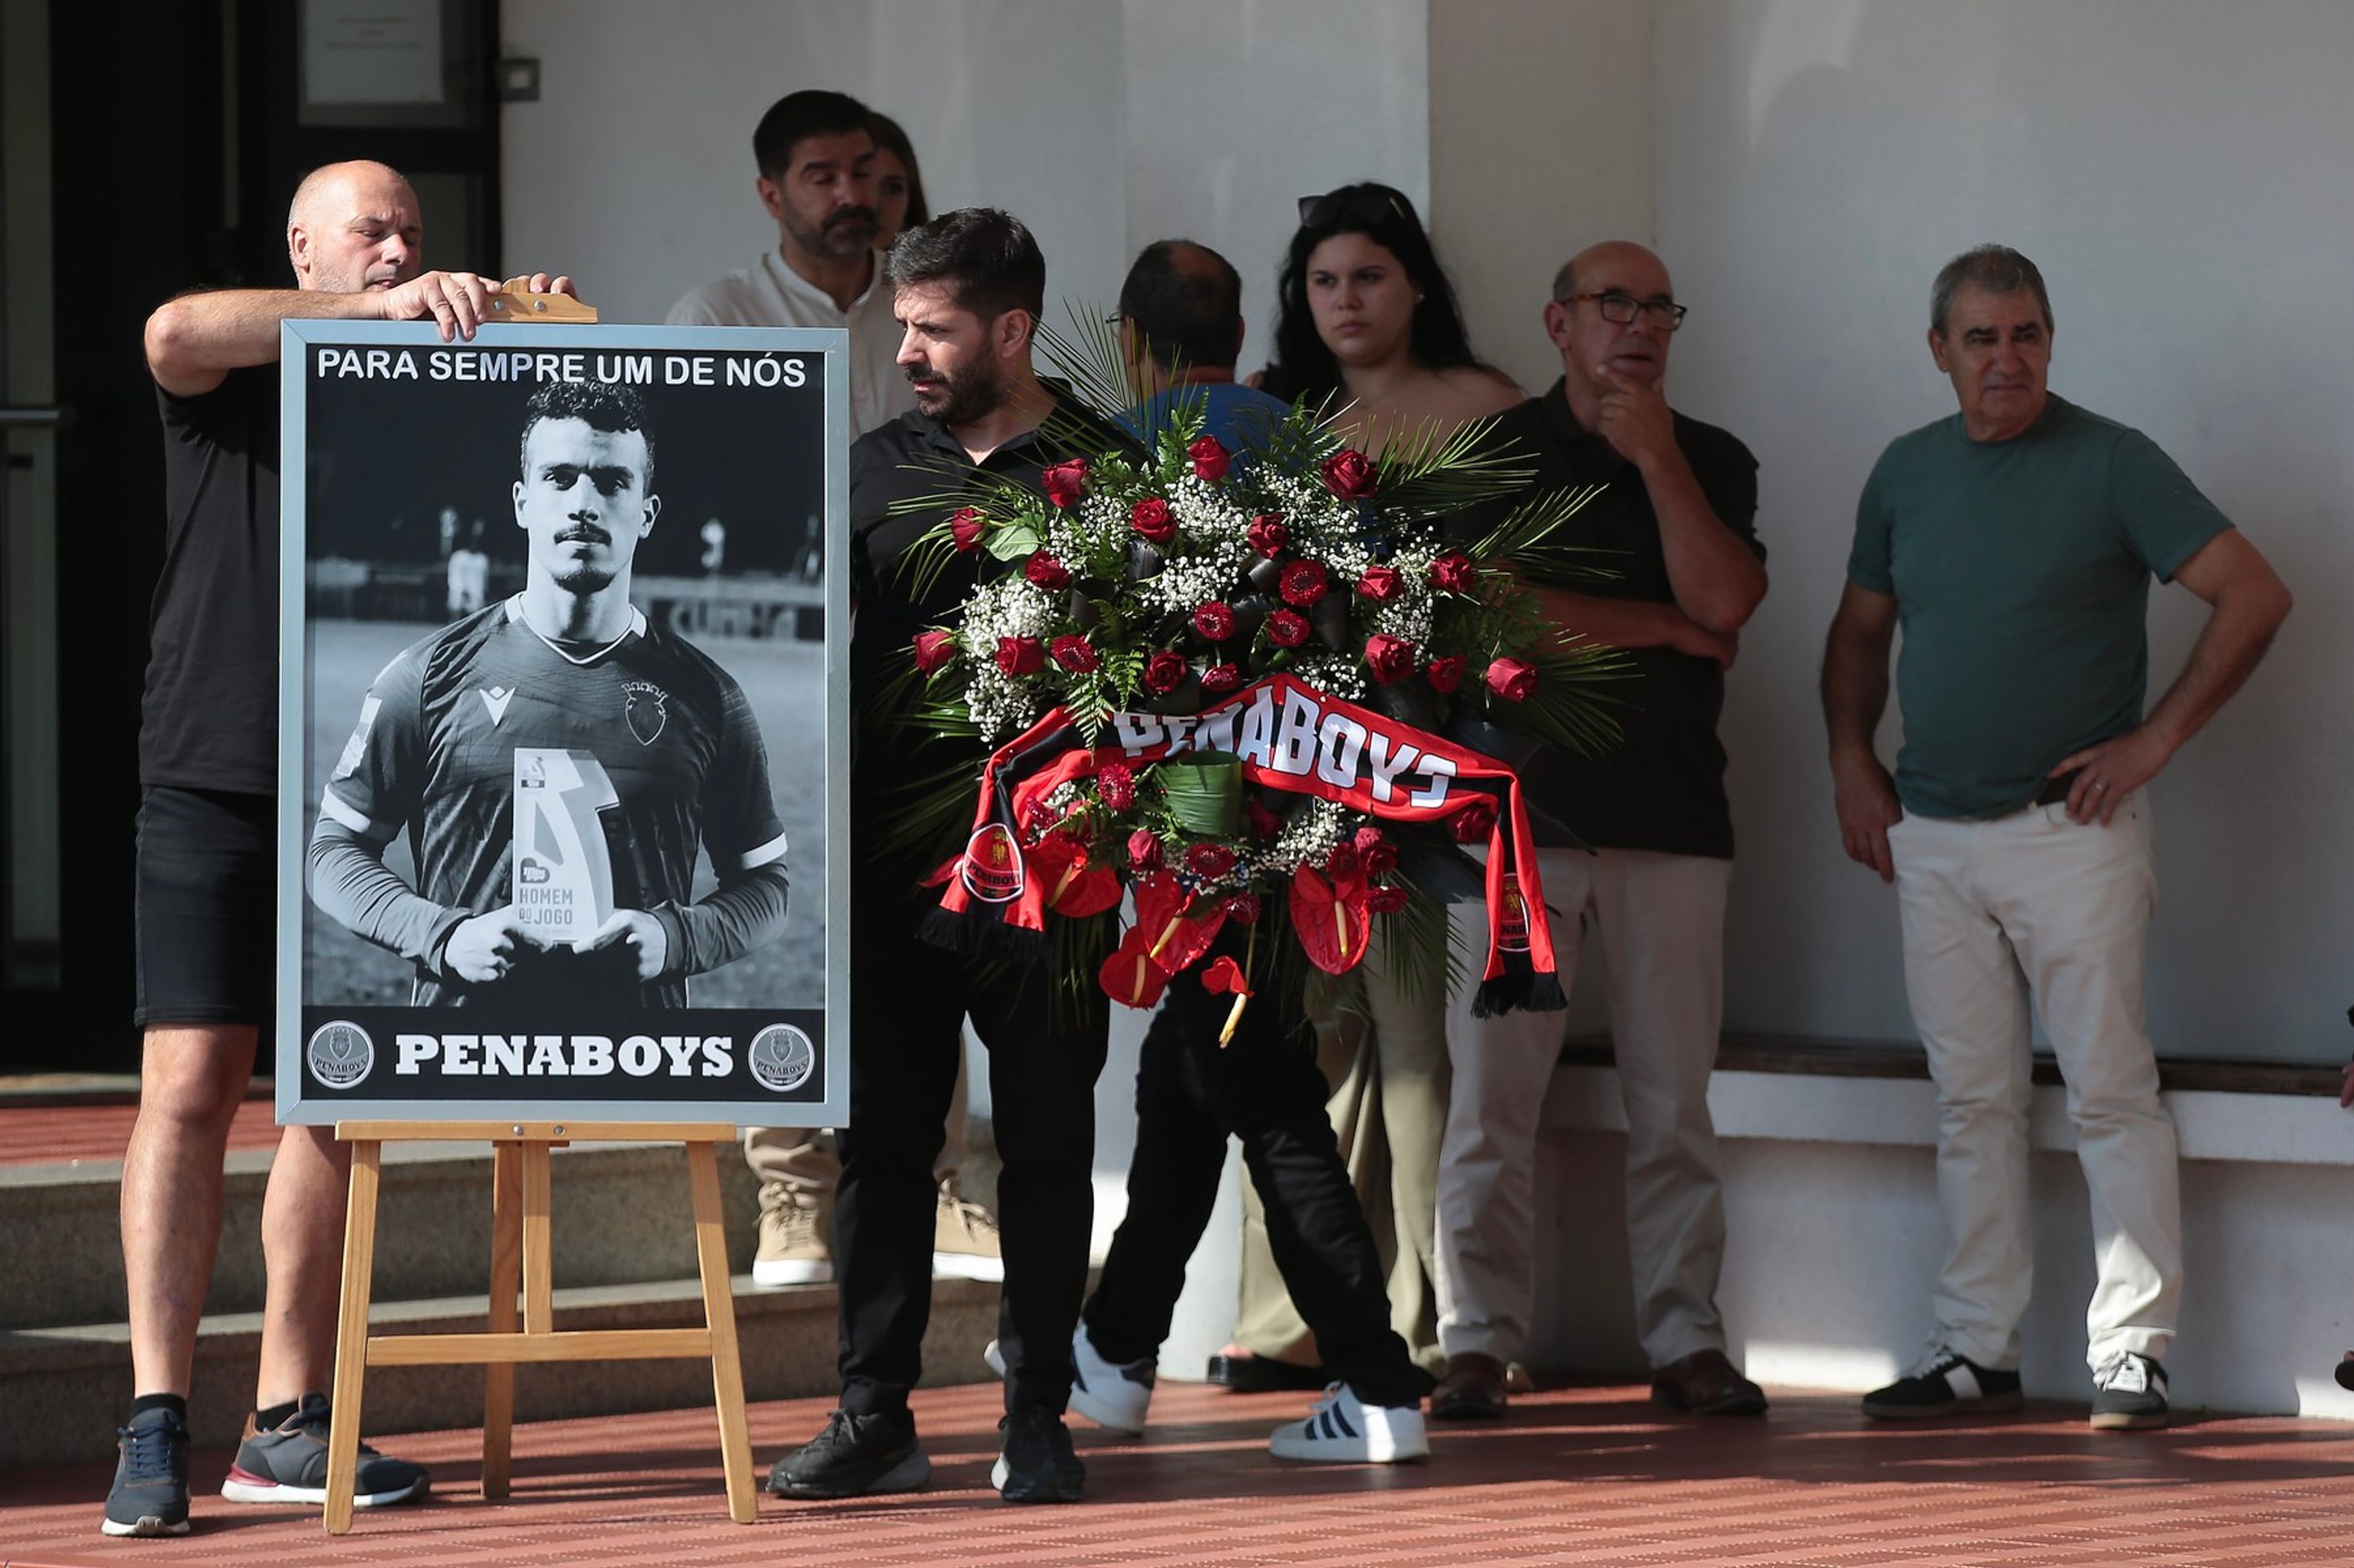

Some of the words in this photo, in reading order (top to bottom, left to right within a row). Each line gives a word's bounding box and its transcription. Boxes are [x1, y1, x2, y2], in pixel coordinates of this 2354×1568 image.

[318, 349, 419, 380] PARA
[429, 351, 586, 384] SEMPRE
[596, 354, 653, 385] UM
[665, 356, 716, 386] DE
[725, 351, 806, 388] NÓS
[519, 889, 573, 904] HOMEM
[533, 908, 573, 925] JOGO
[395, 1034, 733, 1077] PENABOYS
